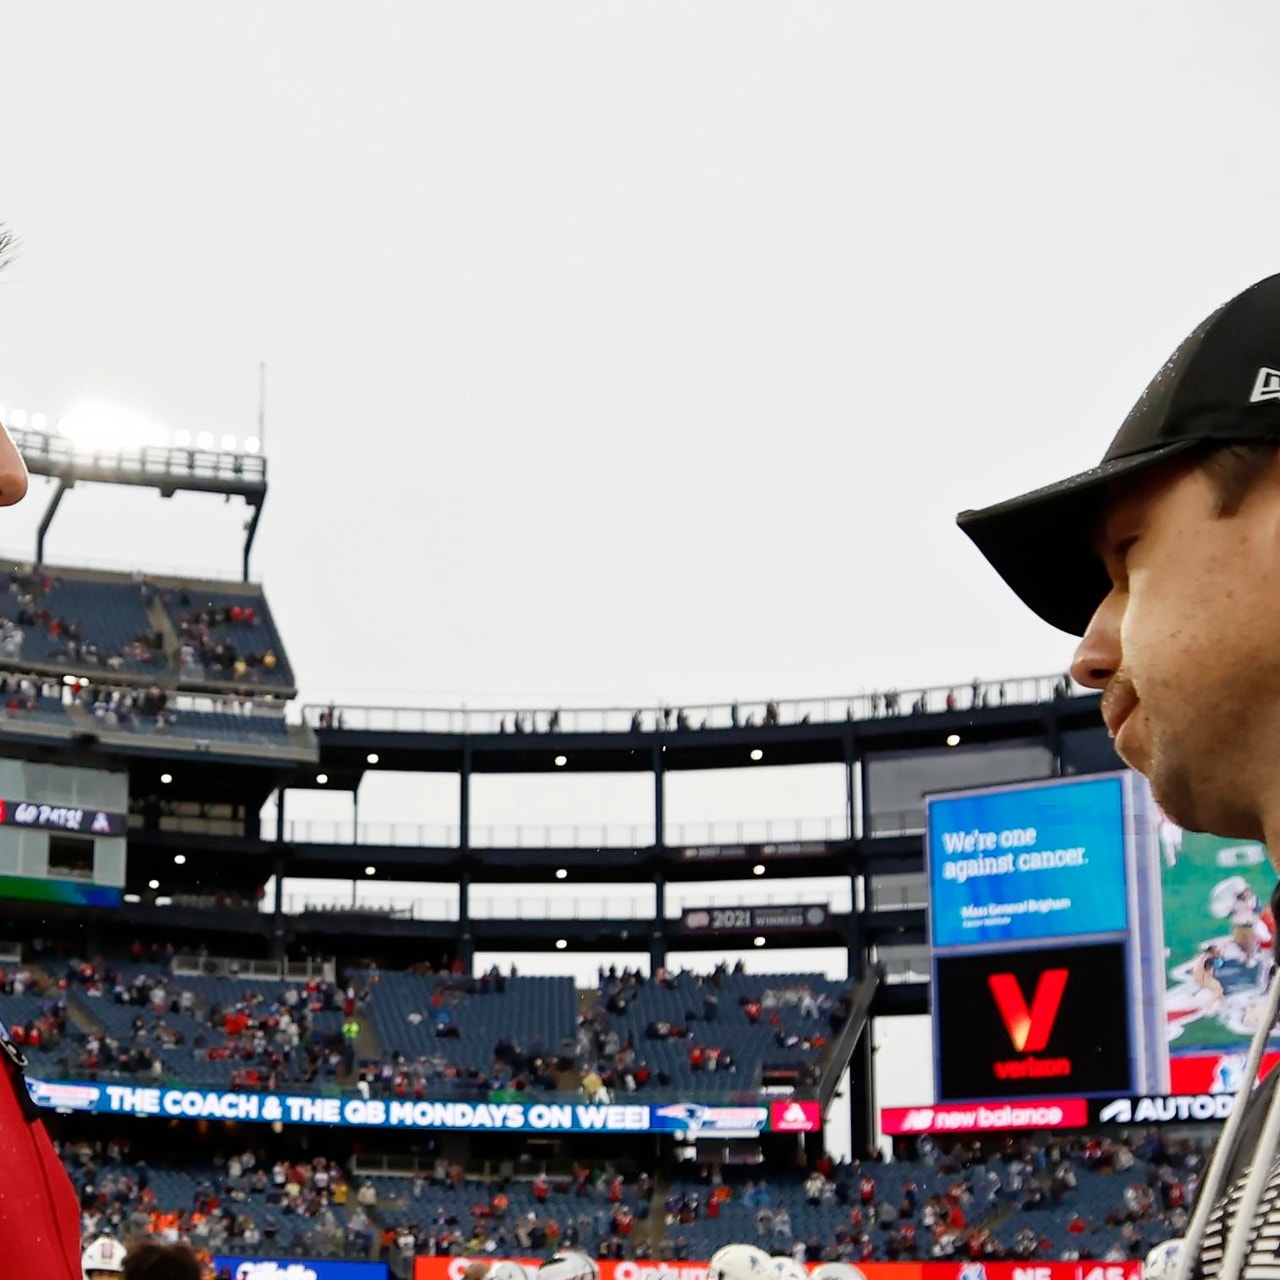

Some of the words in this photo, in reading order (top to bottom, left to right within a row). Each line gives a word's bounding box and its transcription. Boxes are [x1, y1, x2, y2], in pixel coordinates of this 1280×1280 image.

[942, 829, 998, 855] We're
[999, 827, 1038, 849] one
[942, 852, 1016, 884] against
[1016, 846, 1090, 872] cancer.
[711, 910, 752, 928] 2021
[960, 904, 988, 919] Mass
[988, 900, 1028, 916] General
[1028, 898, 1072, 914] Brigham
[993, 1057, 1071, 1080] verizon
[106, 1085, 161, 1113] THE
[163, 1090, 259, 1119] COACH
[261, 1096, 283, 1121] &
[286, 1097, 341, 1123] THE
[389, 1101, 525, 1129] MONDAYS
[526, 1104, 572, 1129] ON
[935, 1108, 978, 1130] new
[979, 1104, 1063, 1128] balance
[1133, 1094, 1237, 1124] AUTOD
